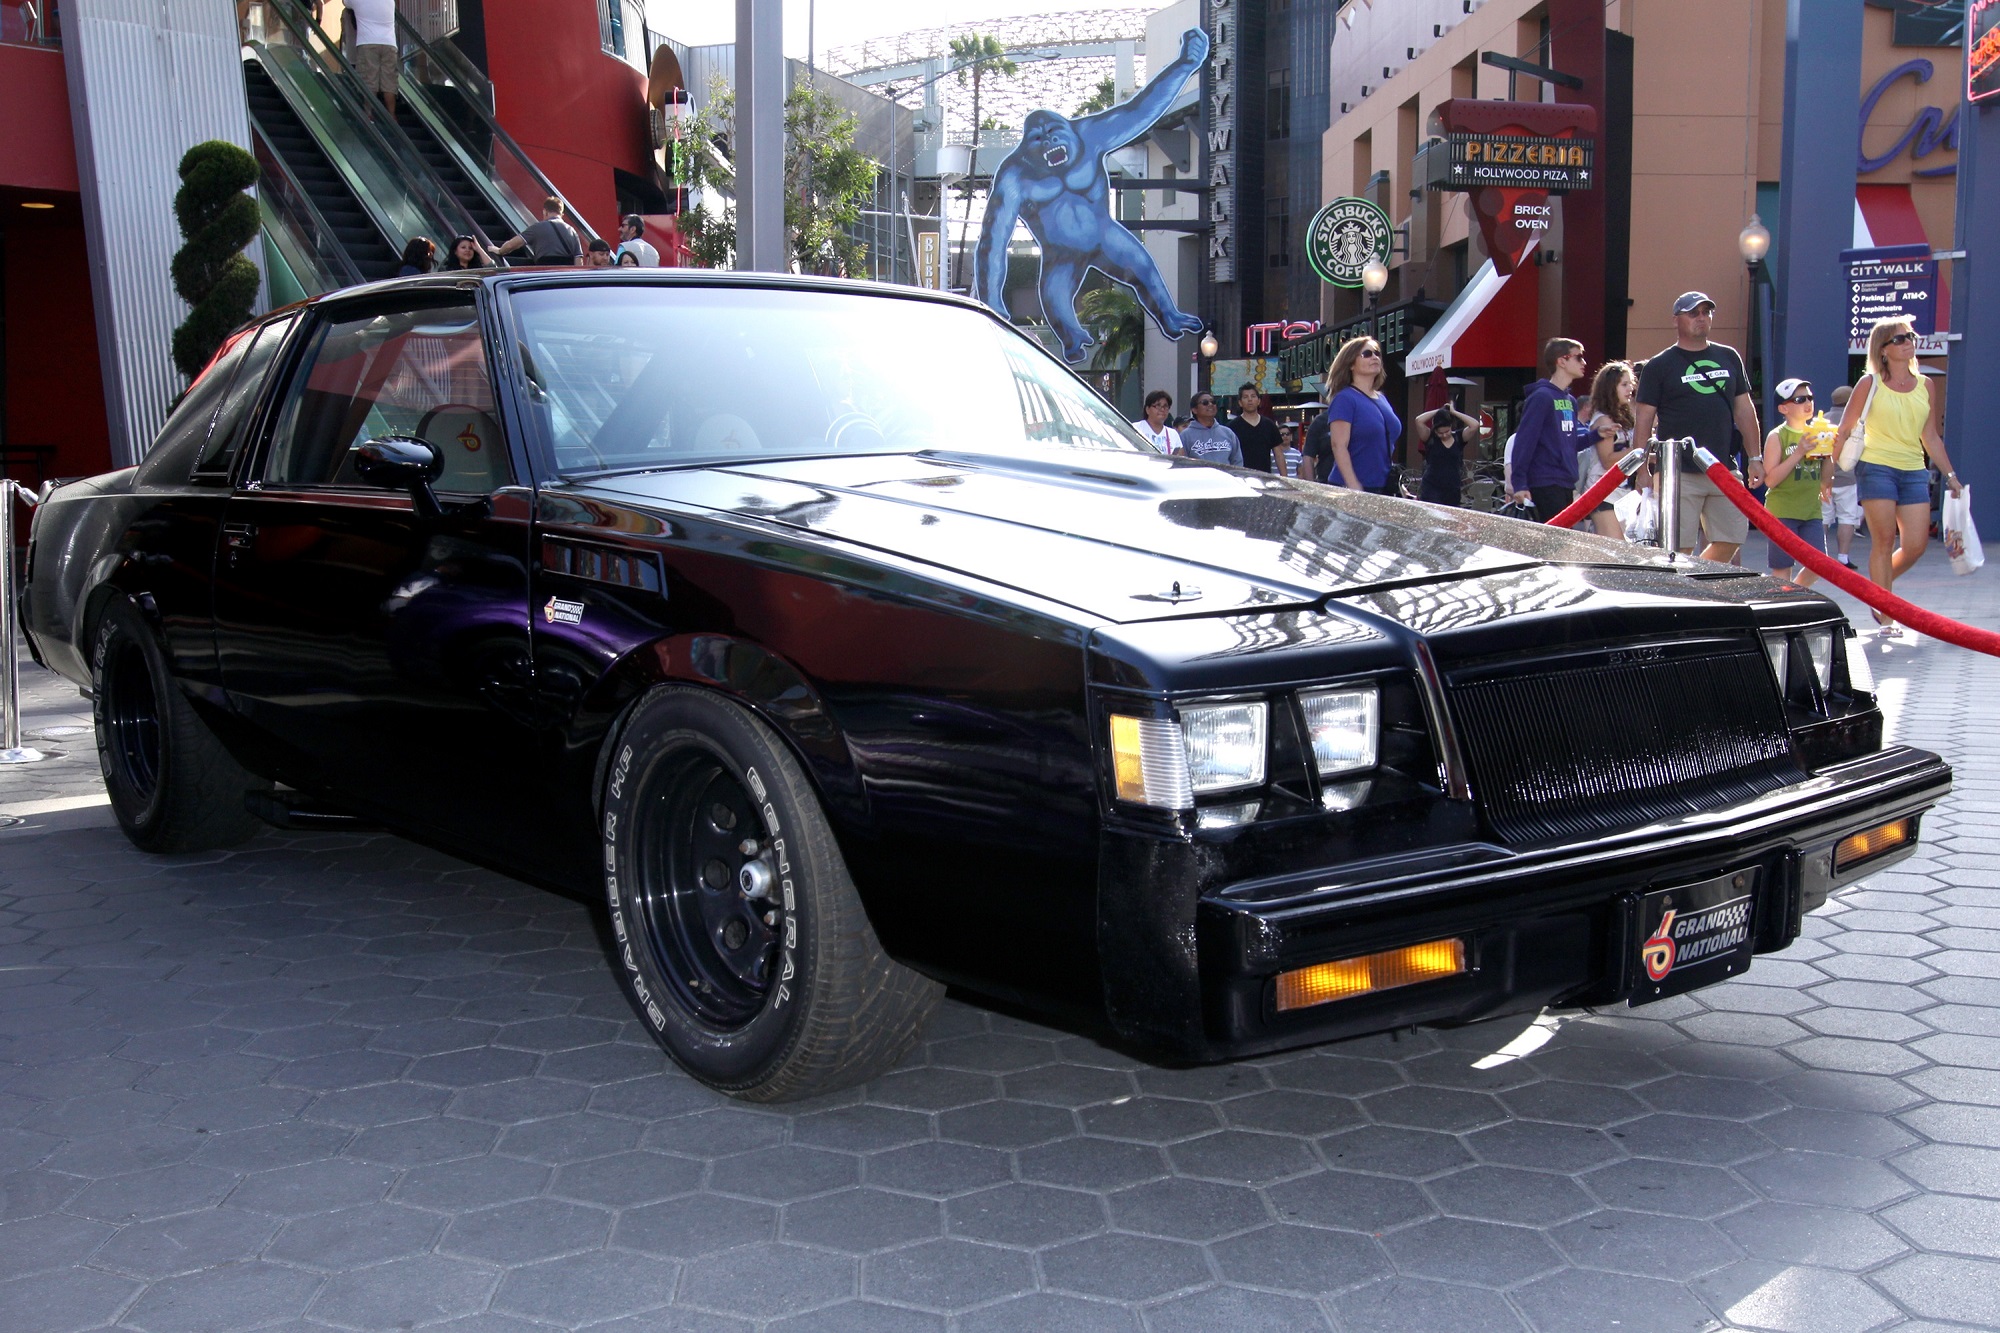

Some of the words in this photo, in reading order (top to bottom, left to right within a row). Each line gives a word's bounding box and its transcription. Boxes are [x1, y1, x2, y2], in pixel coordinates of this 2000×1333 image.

[1465, 141, 1584, 166] PIZZERIA
[1474, 167, 1540, 180] HOLLYWOOD
[1543, 170, 1569, 181] PIZZA
[1514, 205, 1550, 216] BRICK
[1317, 205, 1386, 243] STARBUCKS
[1515, 219, 1549, 230] OVEN
[1326, 258, 1368, 278] COFF
[1850, 263, 1924, 276] CITYWALK
[1902, 292, 1918, 300] ATM
[1861, 305, 1902, 313] Amphitheatre
[1914, 339, 1943, 350] IZZA
[554, 602, 571, 612] GRAND
[554, 611, 579, 622] NATIONAL
[611, 745, 632, 799] HP
[746, 767, 795, 1009] GENERAL
[606, 811, 666, 1031] GRABBER
[1675, 909, 1726, 938] GRAND
[1676, 927, 1744, 962] NATIONAL
